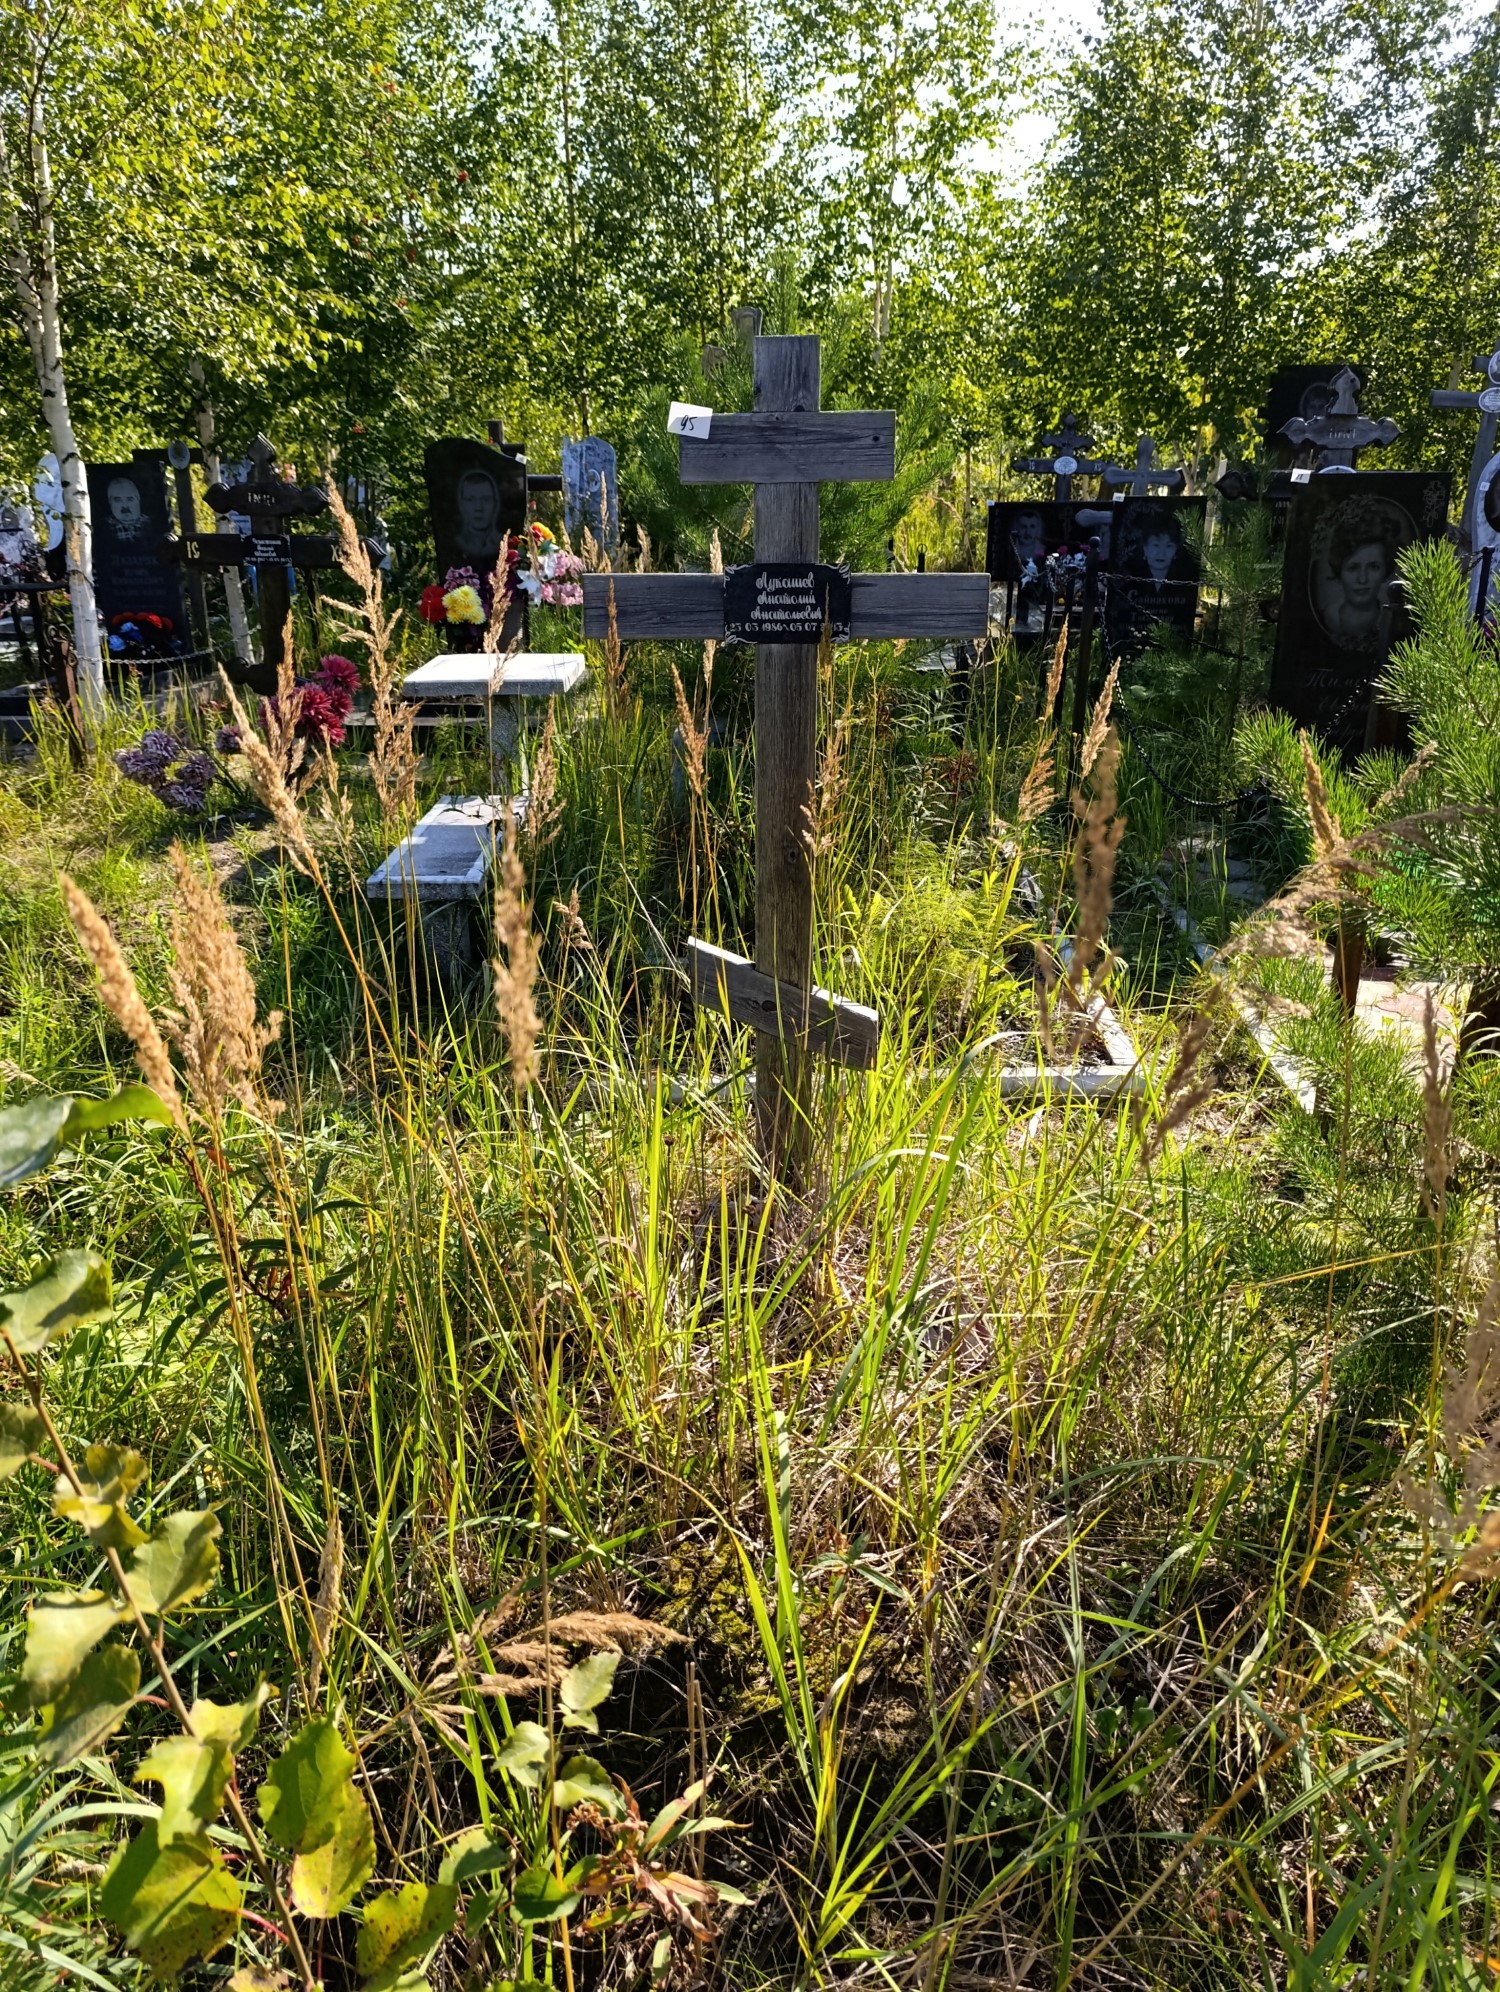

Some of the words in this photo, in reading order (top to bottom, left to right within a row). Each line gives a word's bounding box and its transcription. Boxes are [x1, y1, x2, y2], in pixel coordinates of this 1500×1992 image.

[680, 414, 698, 431] 95
[755, 571, 815, 593] Лукашев
[757, 590, 817, 605] Анатолий
[750, 604, 823, 620] Анатольевич
